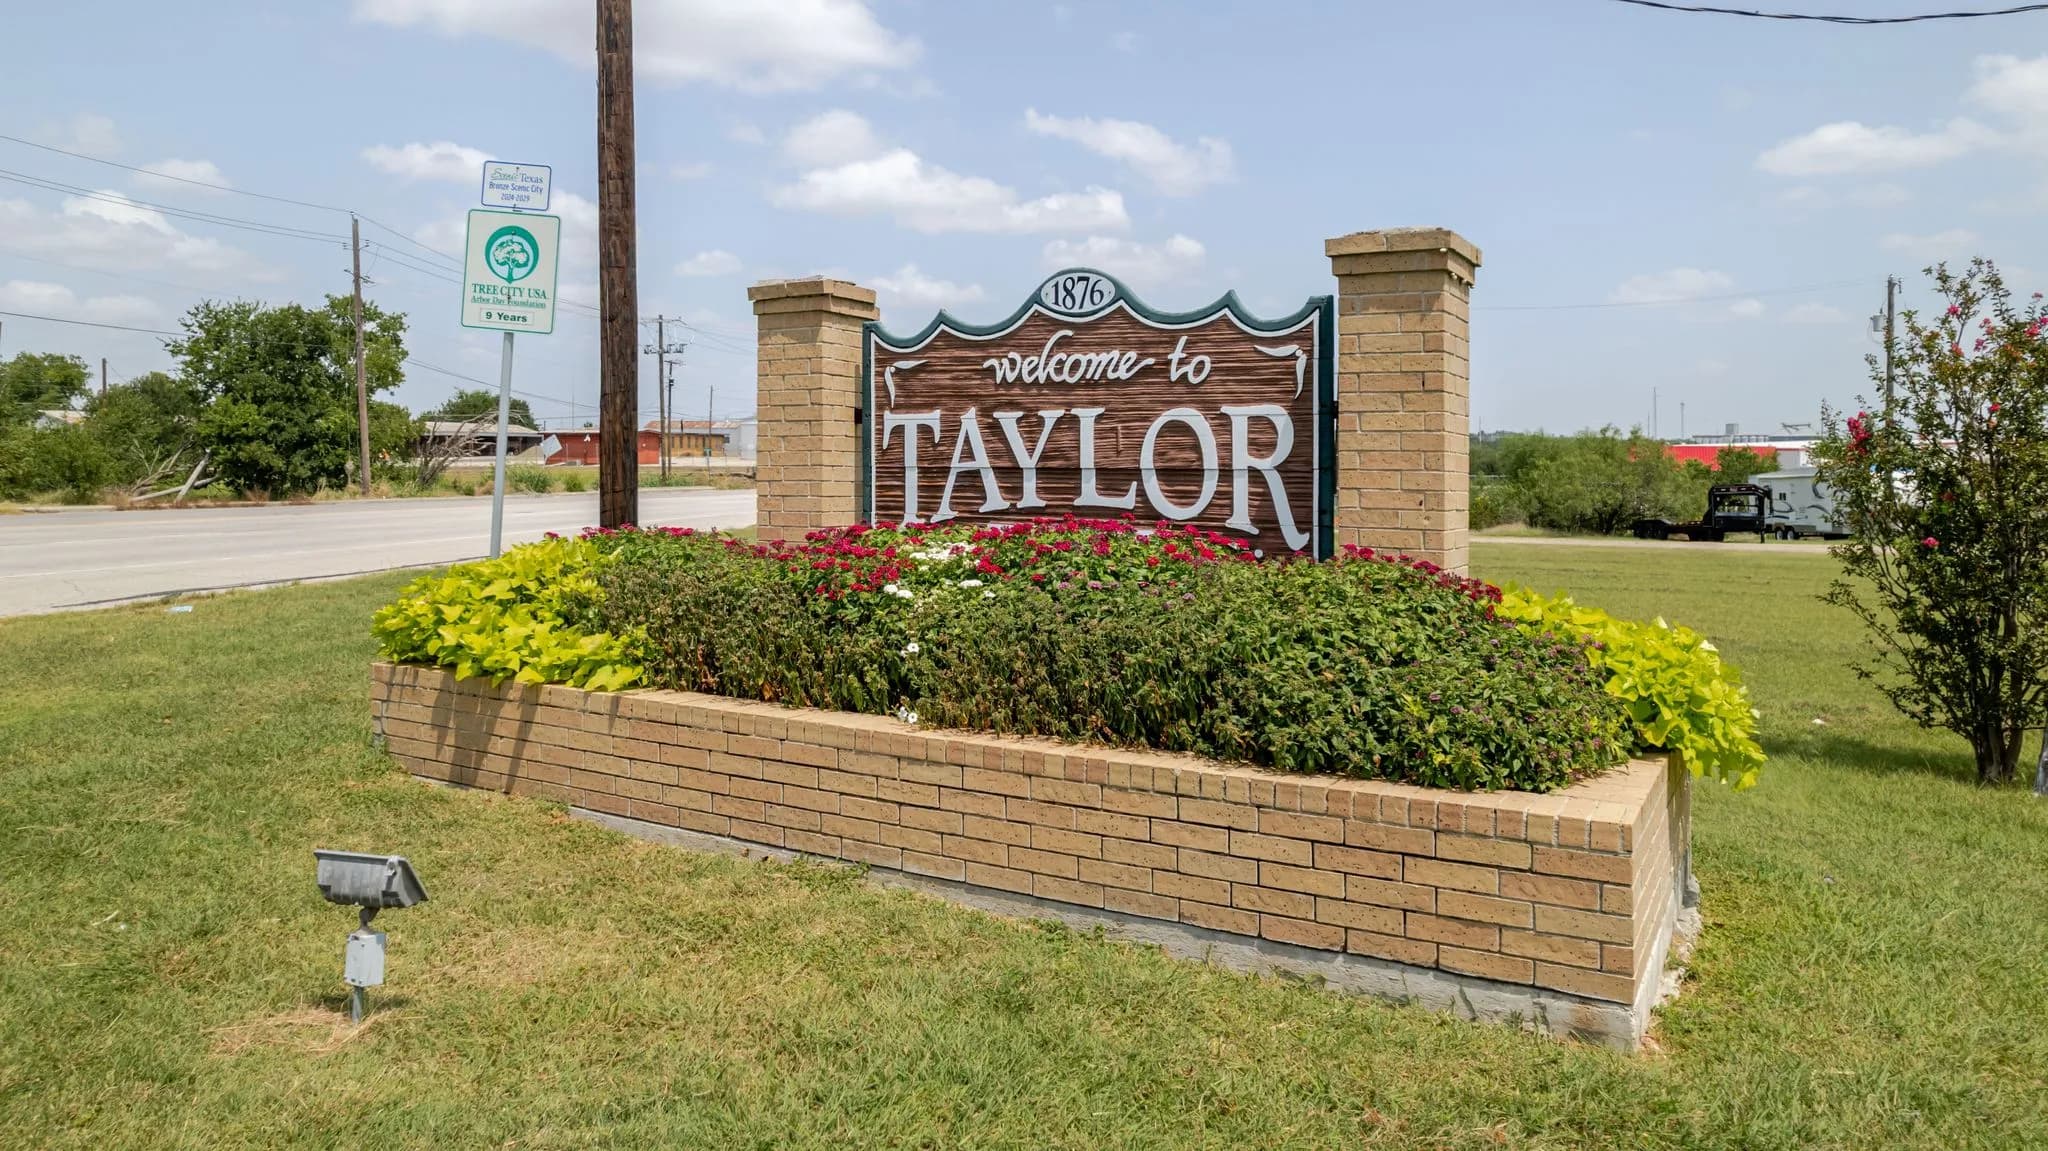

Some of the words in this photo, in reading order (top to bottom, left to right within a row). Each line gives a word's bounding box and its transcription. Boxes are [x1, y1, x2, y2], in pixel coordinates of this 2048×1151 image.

[520, 173, 543, 183] Texas
[489, 181, 510, 190] Bronze
[511, 183, 530, 191] Scenic
[531, 184, 543, 195] City
[472, 283, 498, 295] TREE
[500, 286, 525, 298] CITY
[527, 288, 547, 299] USA
[1051, 276, 1104, 310] 1876
[471, 295, 491, 304] Arbor
[493, 297, 505, 306] Day
[507, 299, 546, 309] Foundation
[485, 311, 492, 319] 9
[497, 312, 527, 322] Years
[982, 329, 1155, 385] welcome
[1166, 335, 1212, 385] to
[882, 403, 1310, 552] TAYLOR
